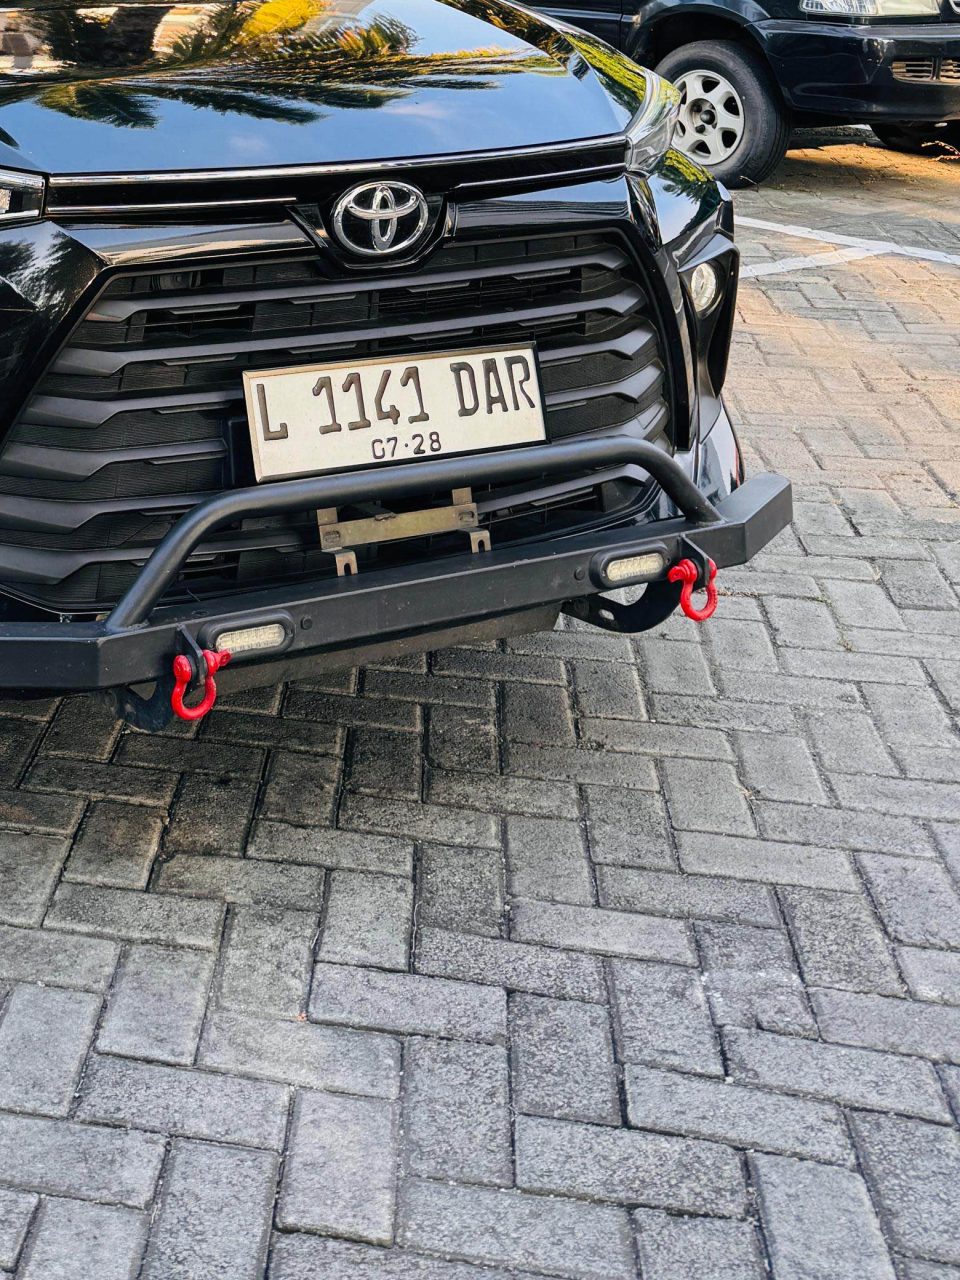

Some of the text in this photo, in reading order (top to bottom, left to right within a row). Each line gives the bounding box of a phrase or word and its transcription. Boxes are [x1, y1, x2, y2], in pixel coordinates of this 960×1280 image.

[256, 355, 536, 441] L 1141 DAR
